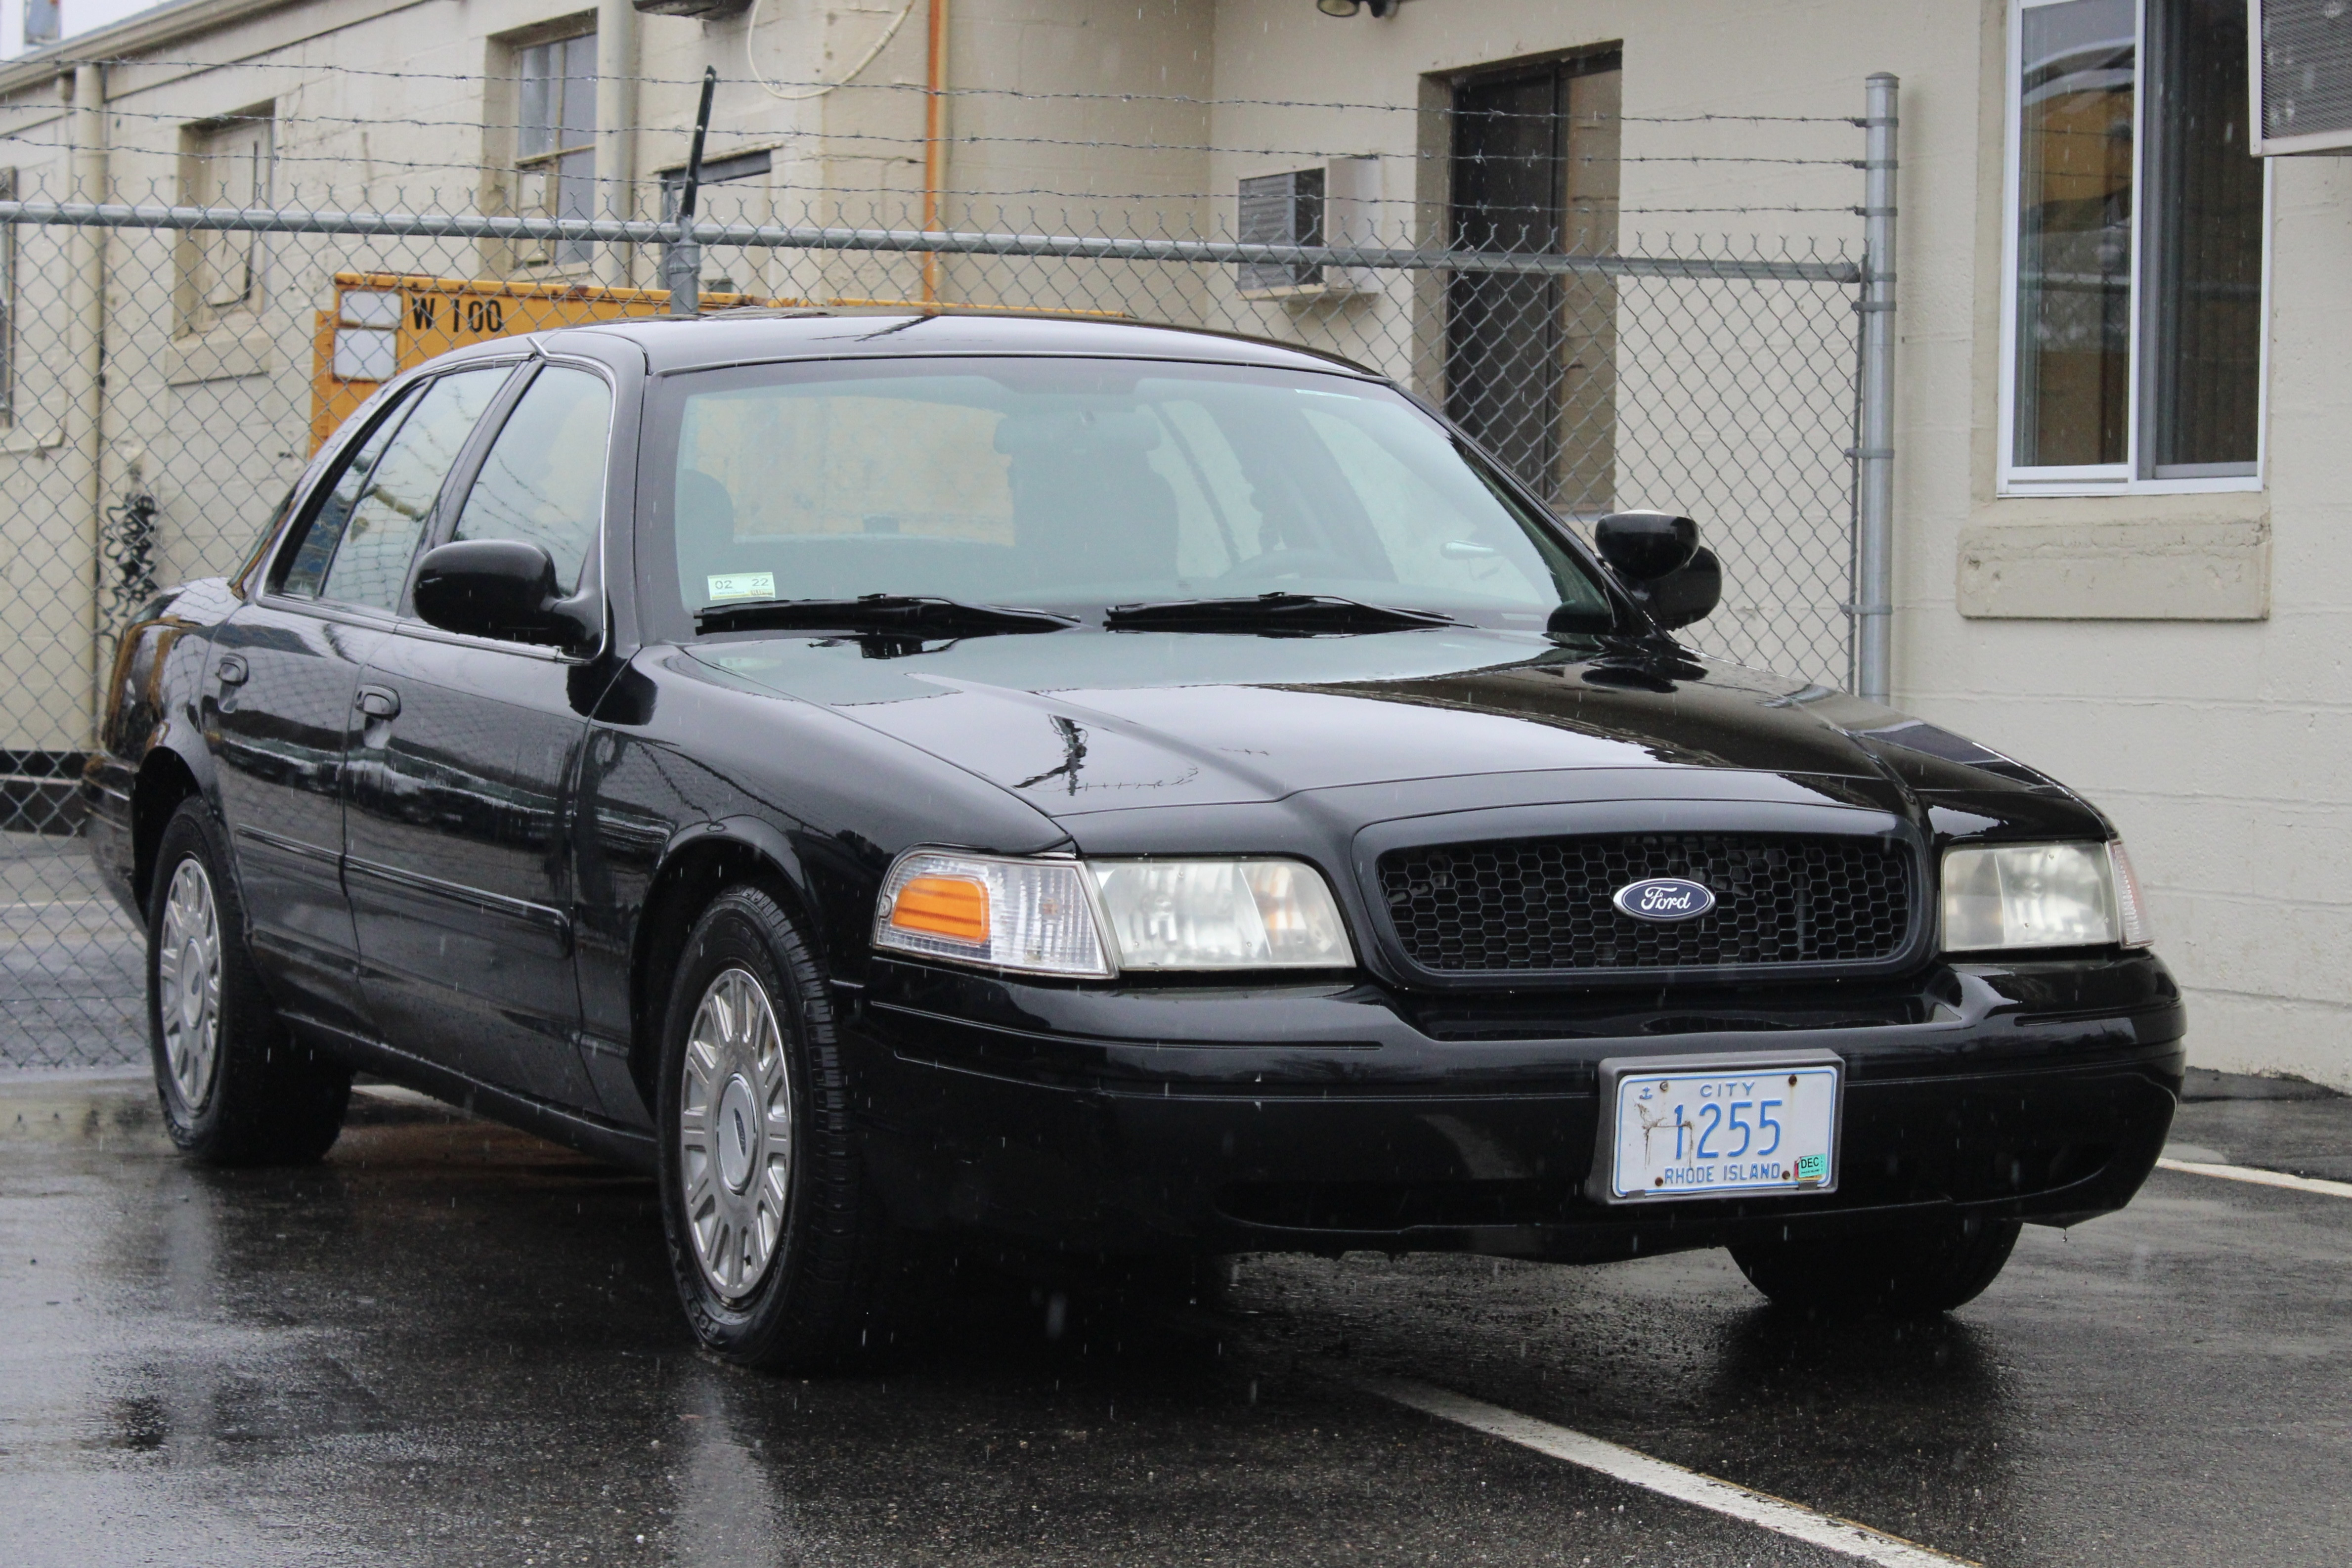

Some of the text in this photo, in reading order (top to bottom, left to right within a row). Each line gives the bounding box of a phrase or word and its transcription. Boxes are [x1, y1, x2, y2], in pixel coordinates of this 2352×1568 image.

[412, 298, 501, 332] W 100
[715, 578, 769, 589] 02 22
[1641, 886, 1691, 910] Ford
[1700, 1082, 1755, 1097] CITY
[1674, 1100, 1782, 1159] 1255
[1664, 1163, 1780, 1184] RHODE ISLAND
[1801, 1157, 1819, 1169] DEC
